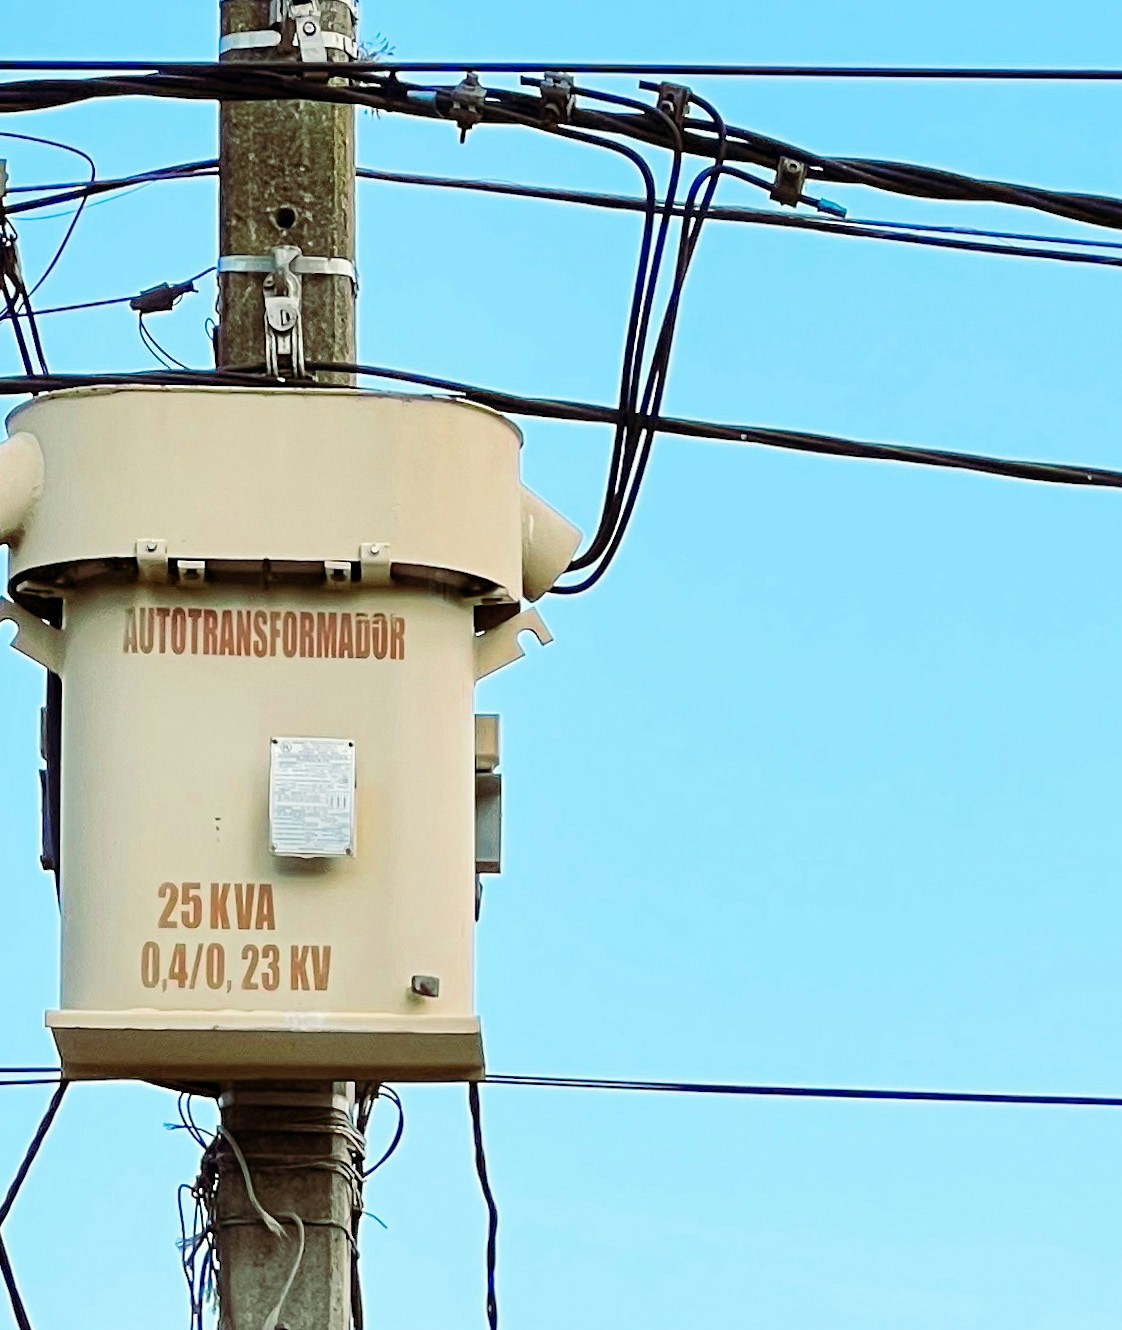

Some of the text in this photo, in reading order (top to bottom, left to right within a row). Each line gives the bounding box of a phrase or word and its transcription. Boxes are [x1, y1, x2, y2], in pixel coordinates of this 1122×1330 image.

[124, 606, 406, 660] AUTOTRANSFORMADOR
[158, 882, 276, 931] 25 KVA
[290, 945, 332, 991] KV
